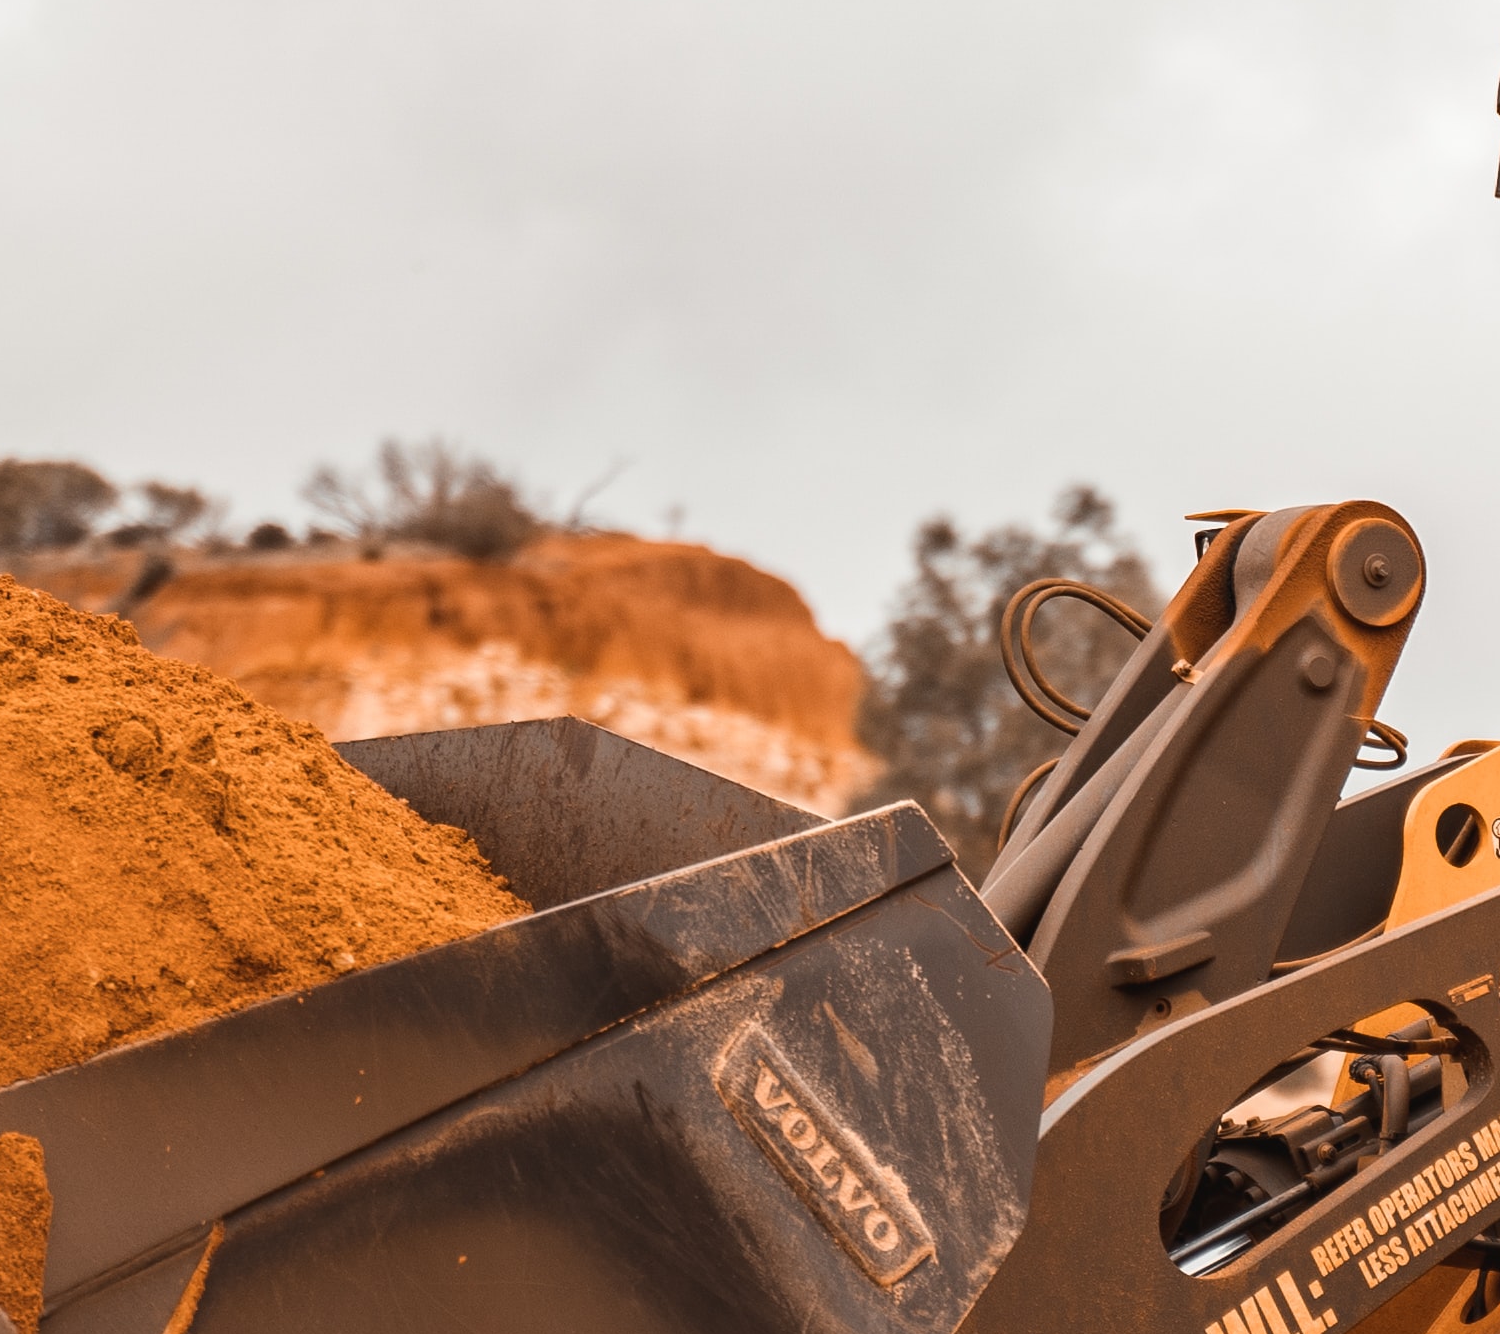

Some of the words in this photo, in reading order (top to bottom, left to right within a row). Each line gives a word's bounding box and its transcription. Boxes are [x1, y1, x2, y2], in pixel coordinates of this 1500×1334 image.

[754, 1058, 899, 1252] VOLVO
[1310, 1217, 1374, 1277] REFER
[1367, 1140, 1479, 1236] OPERATORS
[1357, 1235, 1411, 1290] LESS
